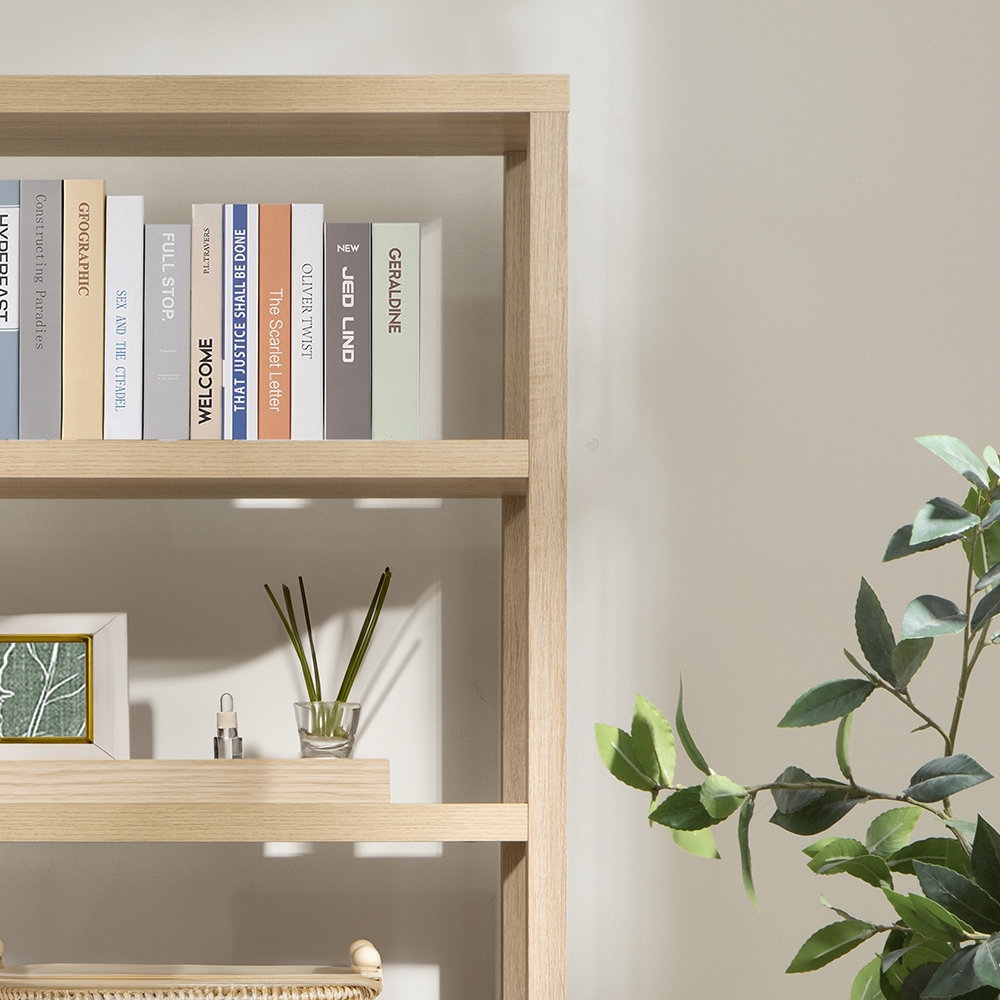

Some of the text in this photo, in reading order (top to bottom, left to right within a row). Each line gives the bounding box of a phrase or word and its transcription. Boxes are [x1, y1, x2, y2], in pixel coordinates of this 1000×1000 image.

[33, 194, 47, 350] Constructing Paradies
[161, 232, 175, 322] FULL STOP.
[337, 244, 360, 253] NEW
[388, 247, 402, 334] GERALDINE
[115, 290, 127, 309] SEX
[115, 315, 127, 335] AND
[233, 229, 246, 412] THAT JUSTICE SHALL BE DONE
[301, 263, 313, 360] OLIVER TWIST
[341, 266, 355, 363] JED LIND
[115, 341, 127, 361] THE
[198, 338, 213, 424] WELCOME
[268, 288, 283, 412] The Scarlet Letter
